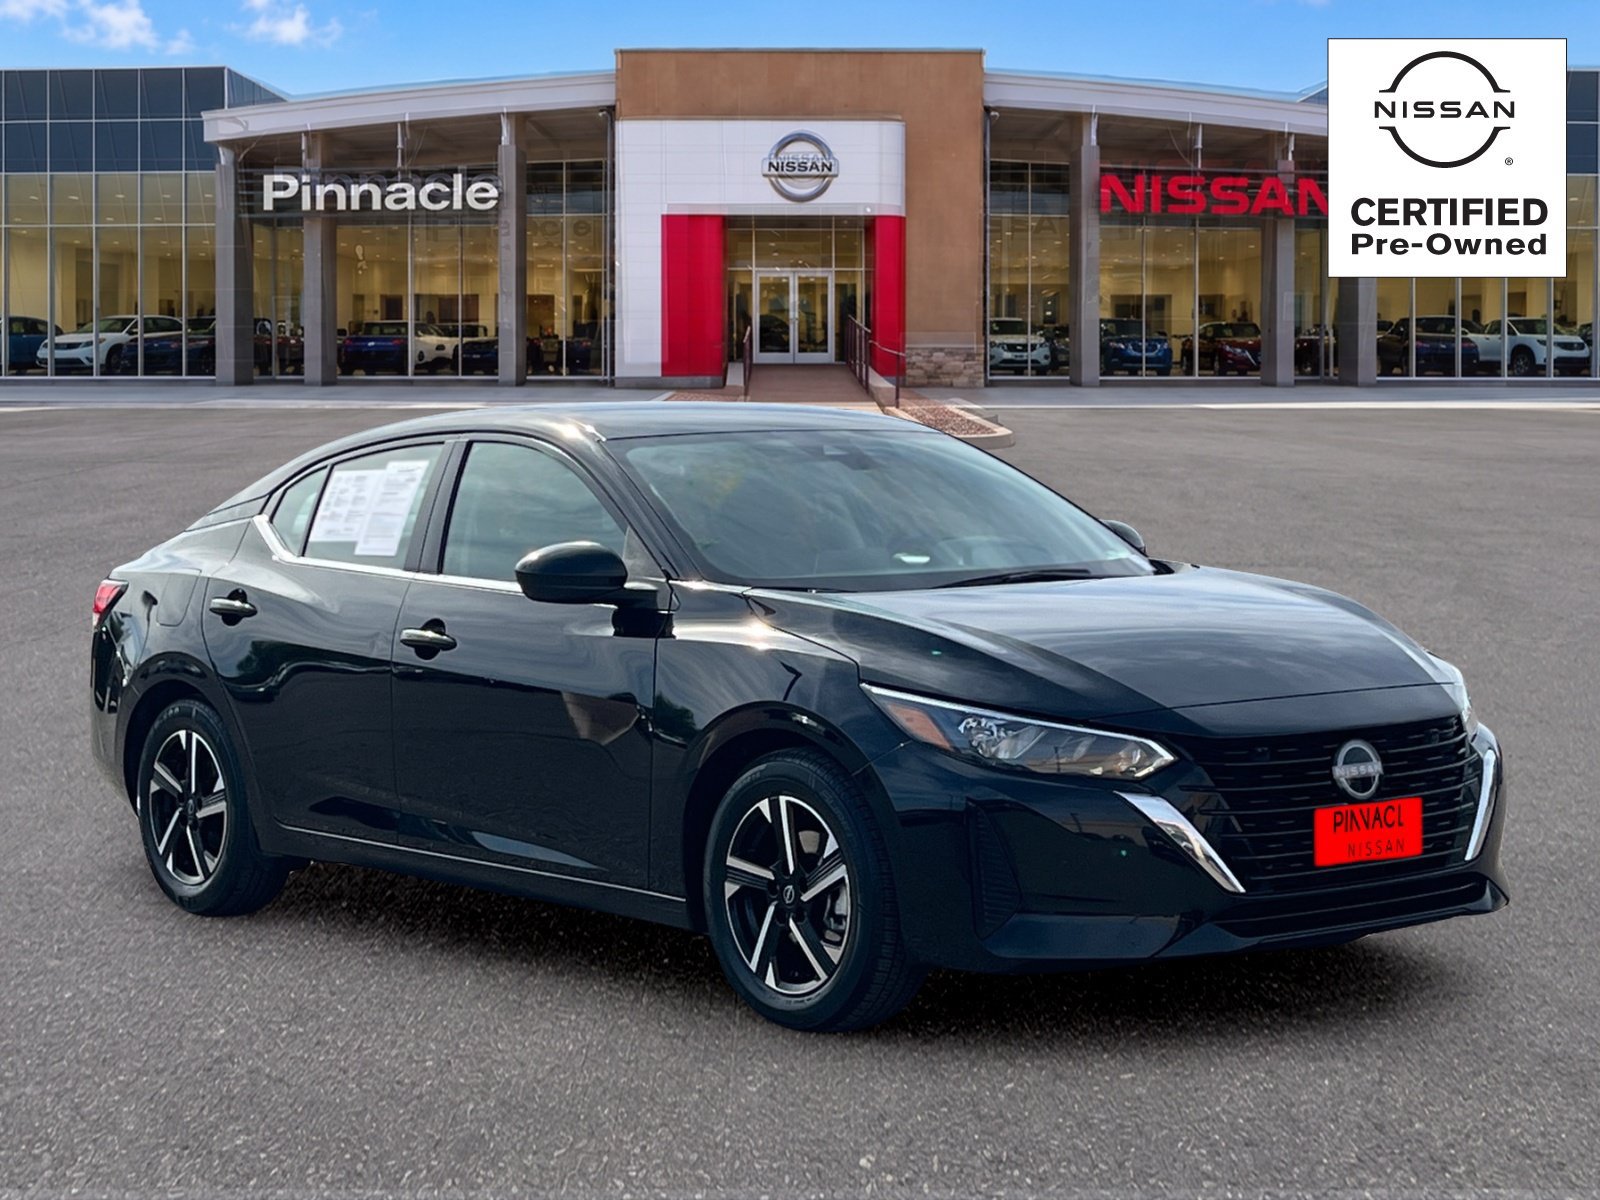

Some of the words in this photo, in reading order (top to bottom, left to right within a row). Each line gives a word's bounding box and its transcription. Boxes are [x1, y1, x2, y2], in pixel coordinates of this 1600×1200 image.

[768, 161, 833, 172] NISSAN
[263, 173, 499, 211] Pinnacle
[1347, 838, 1405, 858] NISSAN
